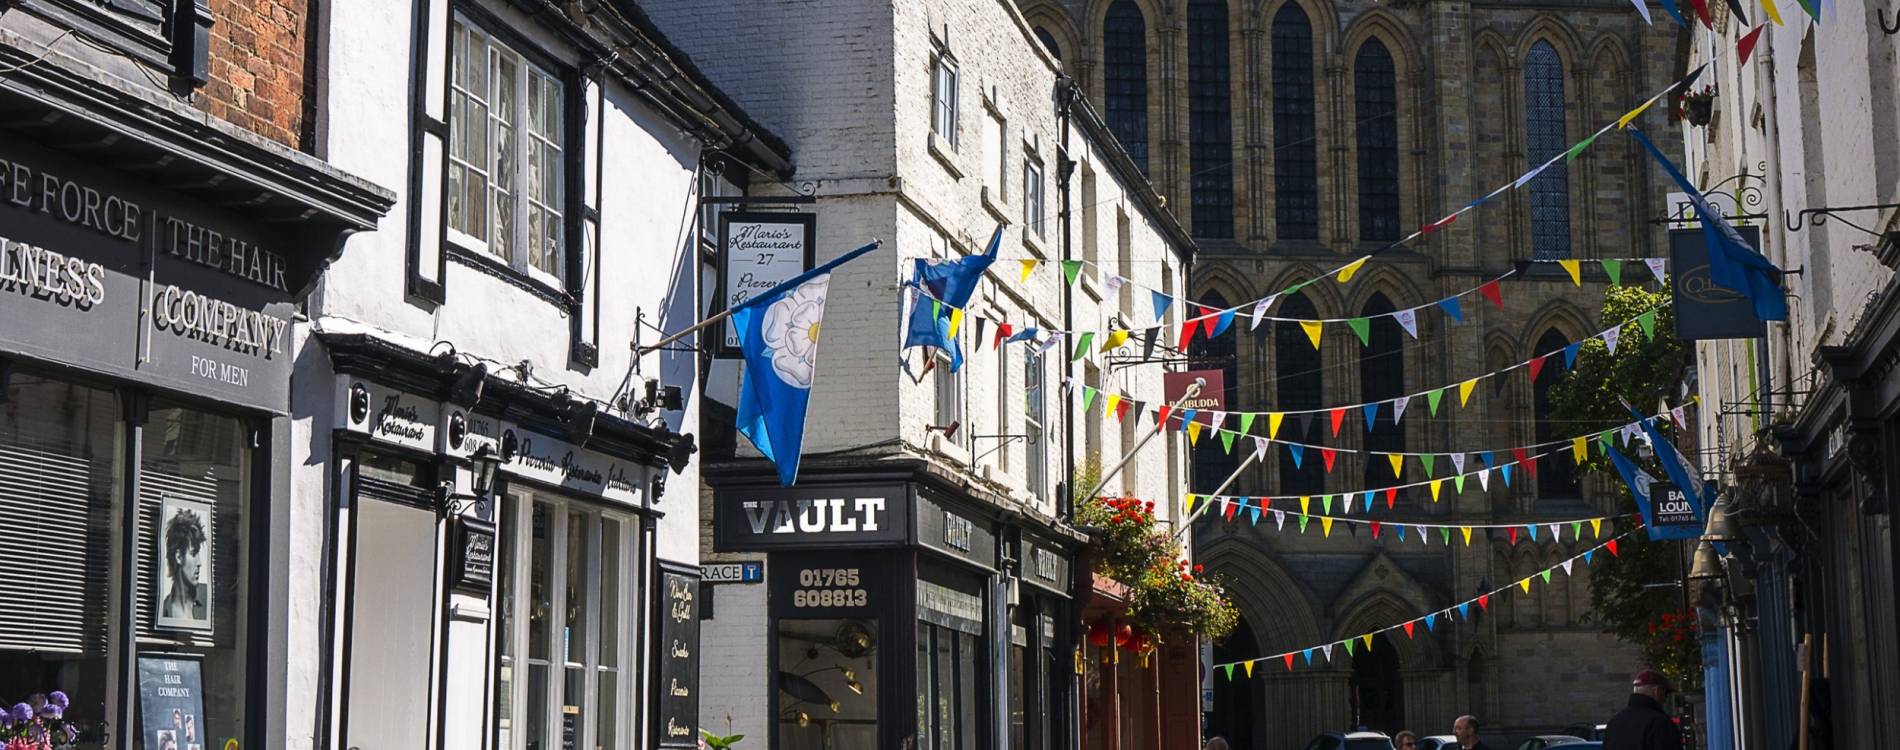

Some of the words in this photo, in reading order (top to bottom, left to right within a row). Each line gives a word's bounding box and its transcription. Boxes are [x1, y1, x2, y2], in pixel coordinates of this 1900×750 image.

[41, 172, 141, 242] FORCE
[736, 224, 792, 242] Mario's
[729, 236, 802, 251] Restaurant
[166, 215, 224, 269] THE
[229, 237, 289, 292] HAIR
[756, 253, 774, 266] 27
[737, 272, 784, 288] Pizzer
[164, 284, 288, 353] COMPANY
[191, 355, 217, 380] FOR
[220, 362, 249, 387] MEN
[745, 497, 886, 534] VAULT
[800, 568, 860, 587] 01765
[793, 588, 868, 608] 608813
[164, 674, 182, 684] HAIR
[158, 687, 190, 697] COMPANY
